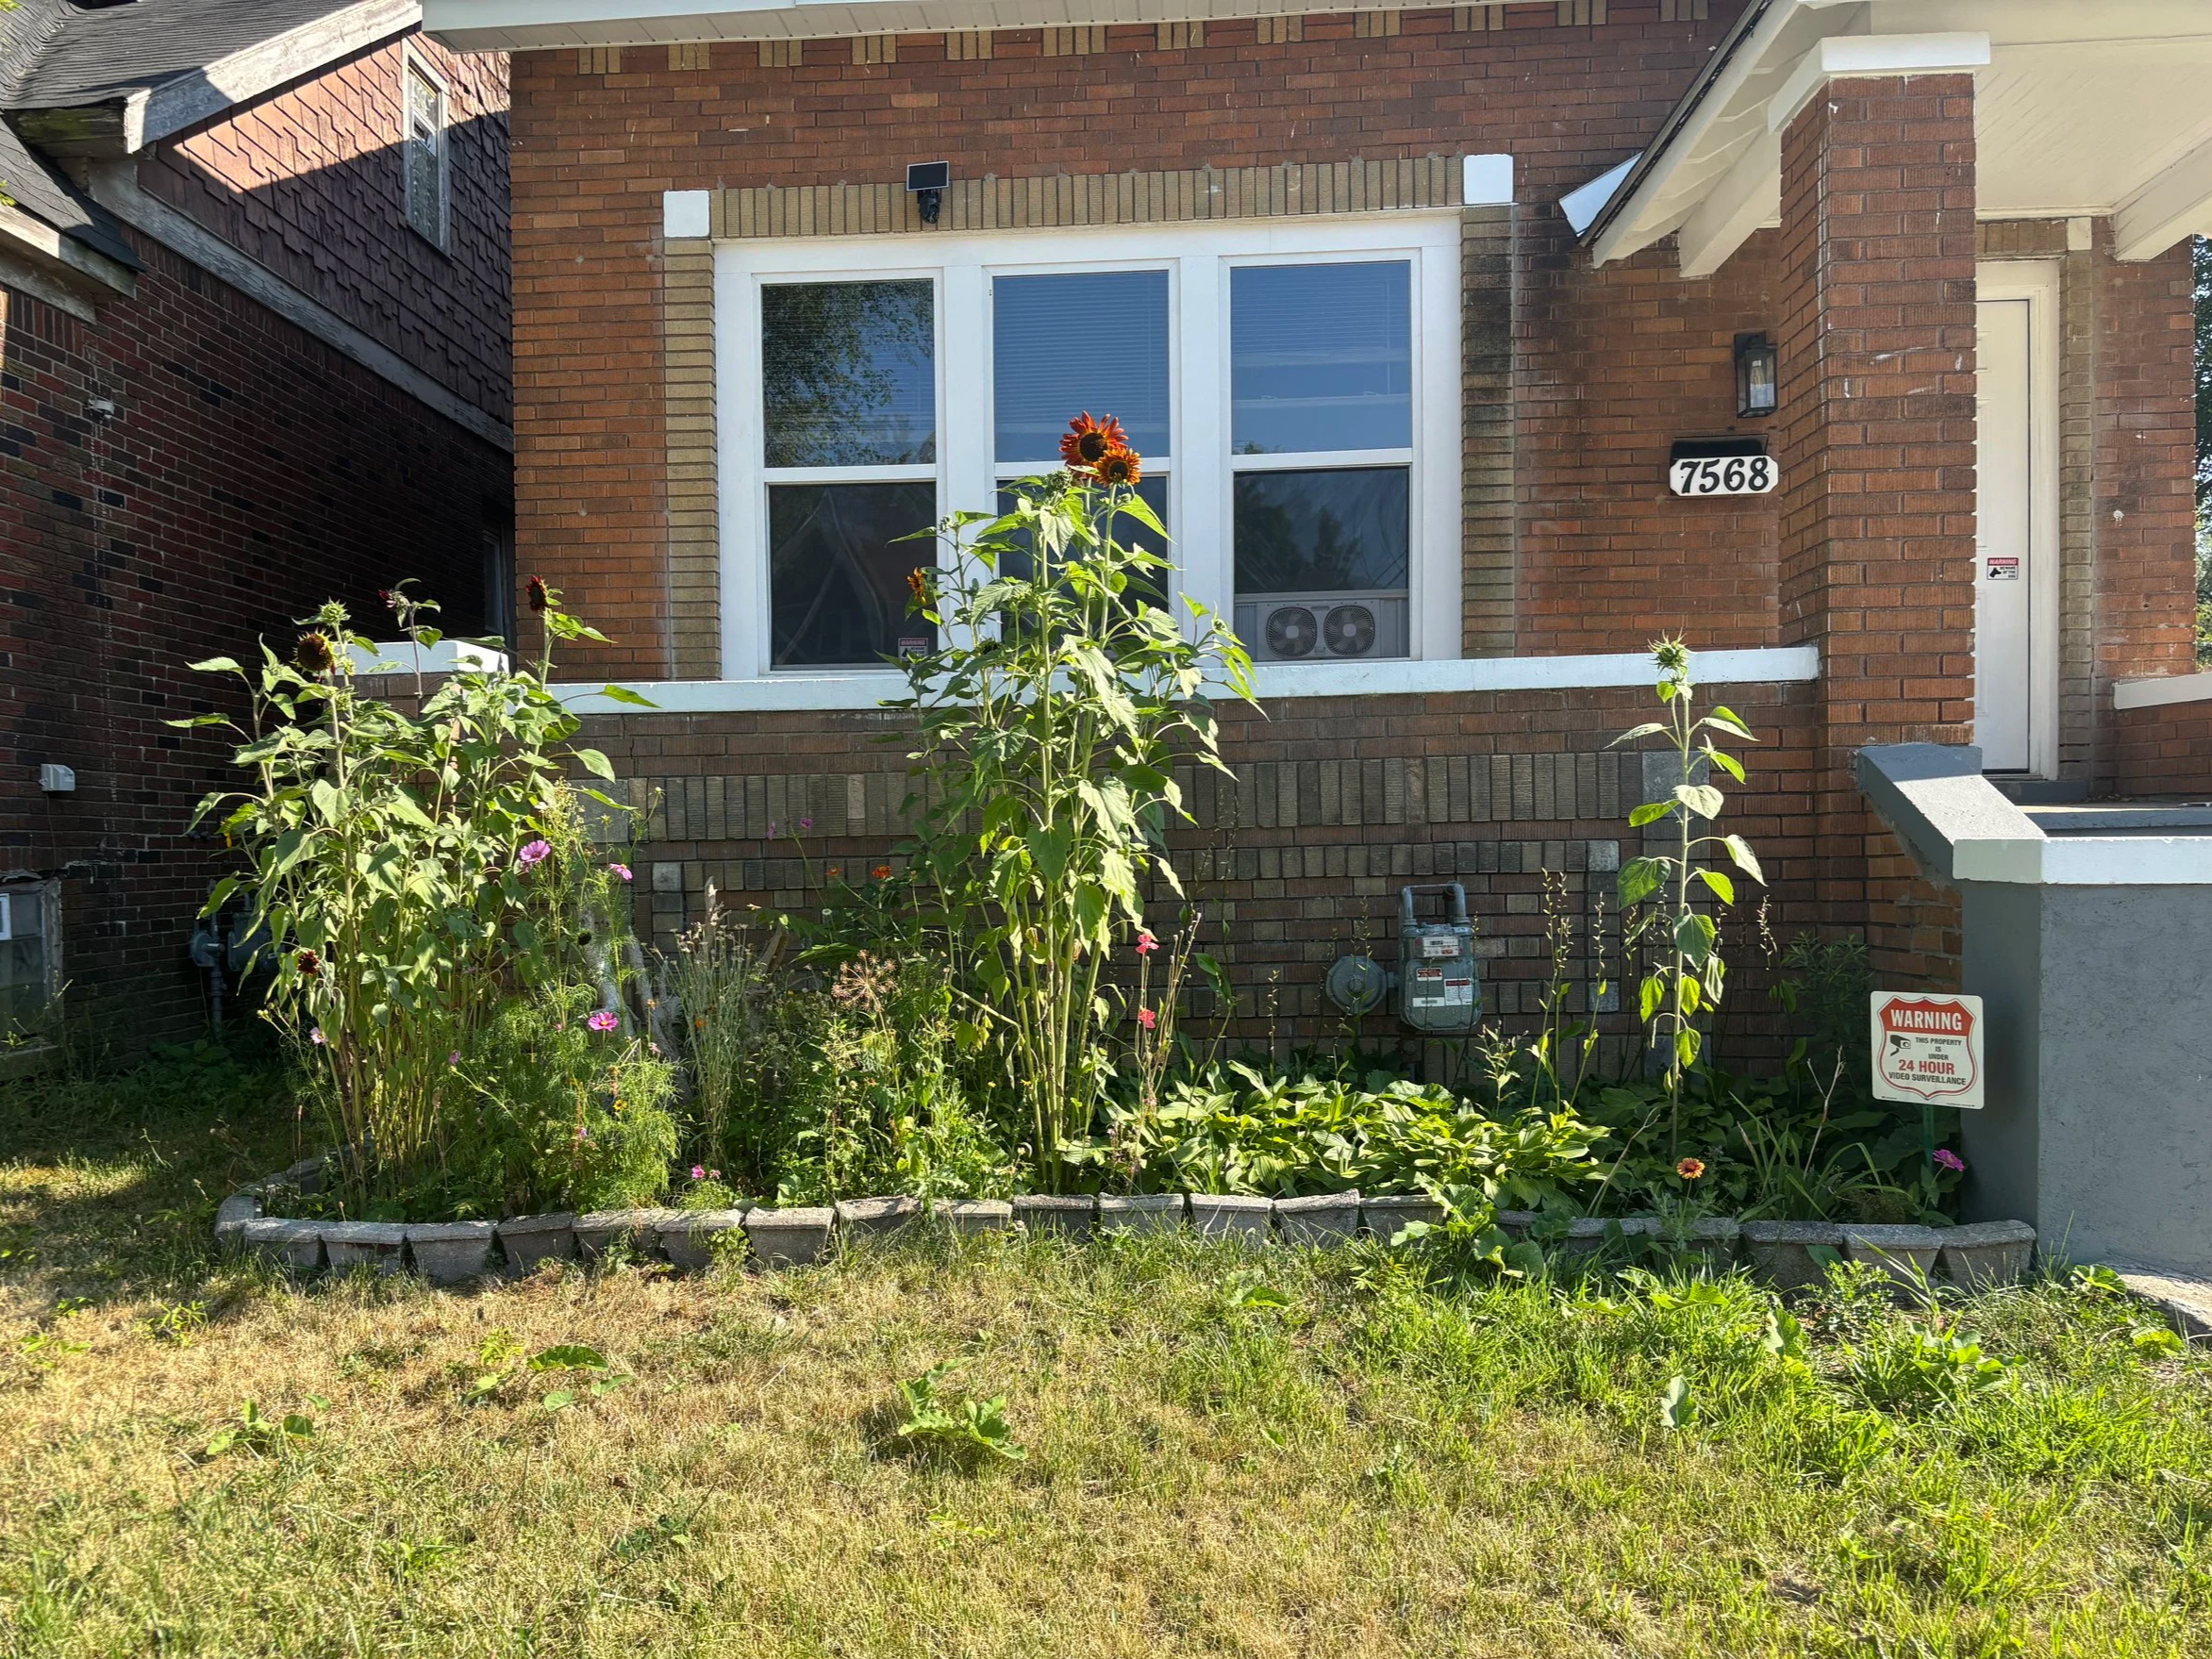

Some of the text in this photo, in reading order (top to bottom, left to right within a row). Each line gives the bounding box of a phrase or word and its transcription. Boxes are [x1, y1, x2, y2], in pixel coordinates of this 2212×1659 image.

[1680, 457, 1769, 494] 7568
[1890, 1009, 1962, 1031] WARNING
[1898, 1059, 1955, 1075] 24 HOUR
[1888, 1071, 1966, 1086] VIDEO SURVEILLANCE
